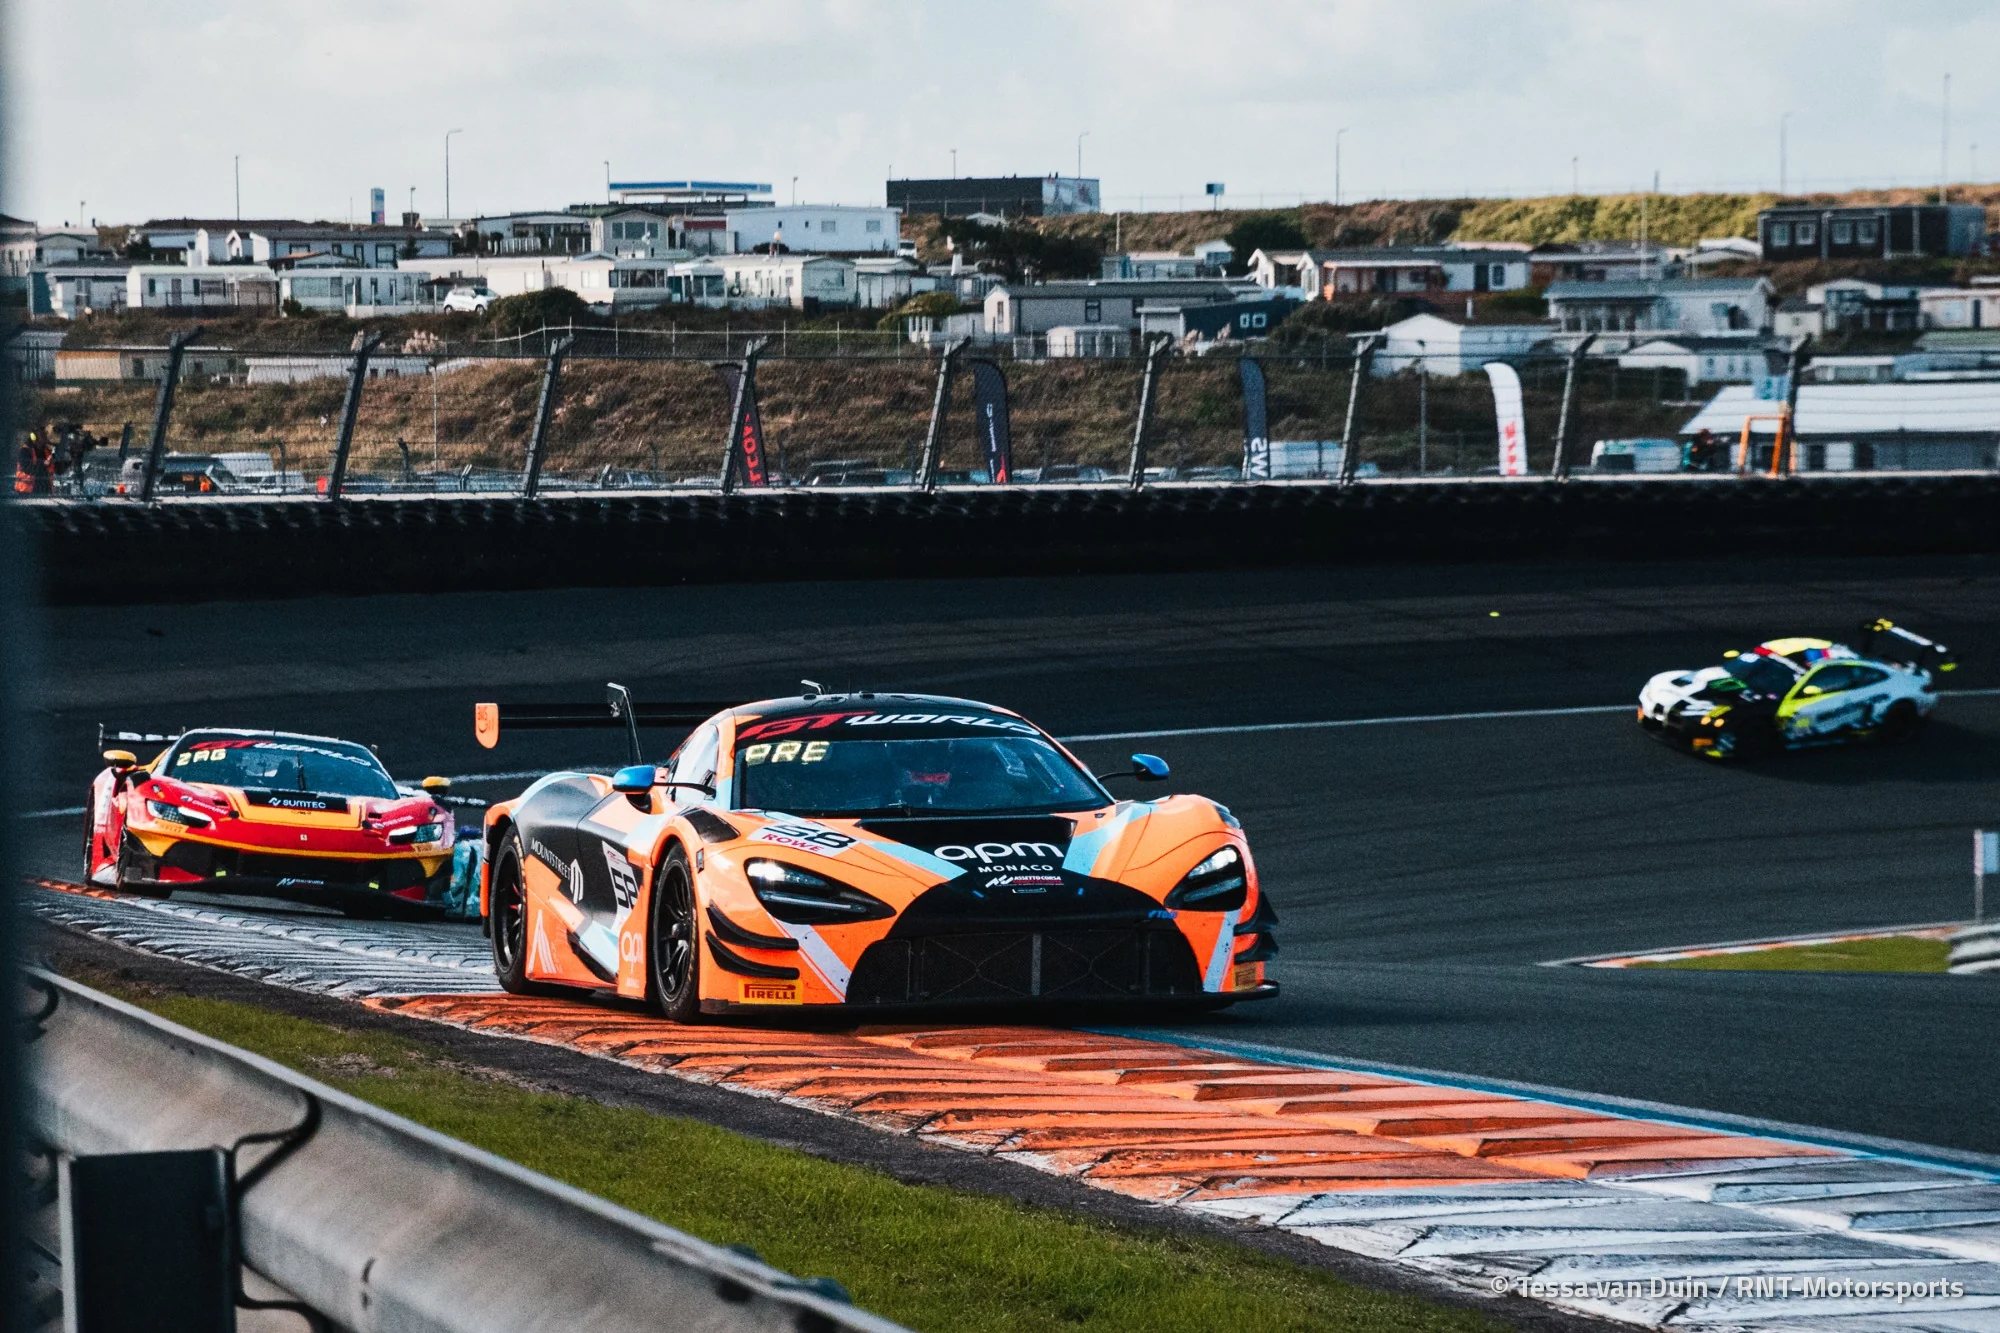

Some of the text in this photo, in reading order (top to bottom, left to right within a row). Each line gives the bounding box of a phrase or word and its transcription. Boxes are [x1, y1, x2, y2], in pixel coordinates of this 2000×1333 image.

[736, 711, 1041, 740] GT WORLD
[745, 741, 829, 763] PRE
[282, 799, 326, 809] SUMTEC
[762, 833, 824, 851] ROWE
[763, 824, 856, 848] 58
[531, 837, 571, 880] MOUNTSTREET
[934, 842, 1064, 864] apm
[977, 864, 1053, 873] MONACO
[744, 983, 796, 999] PIRELLI
